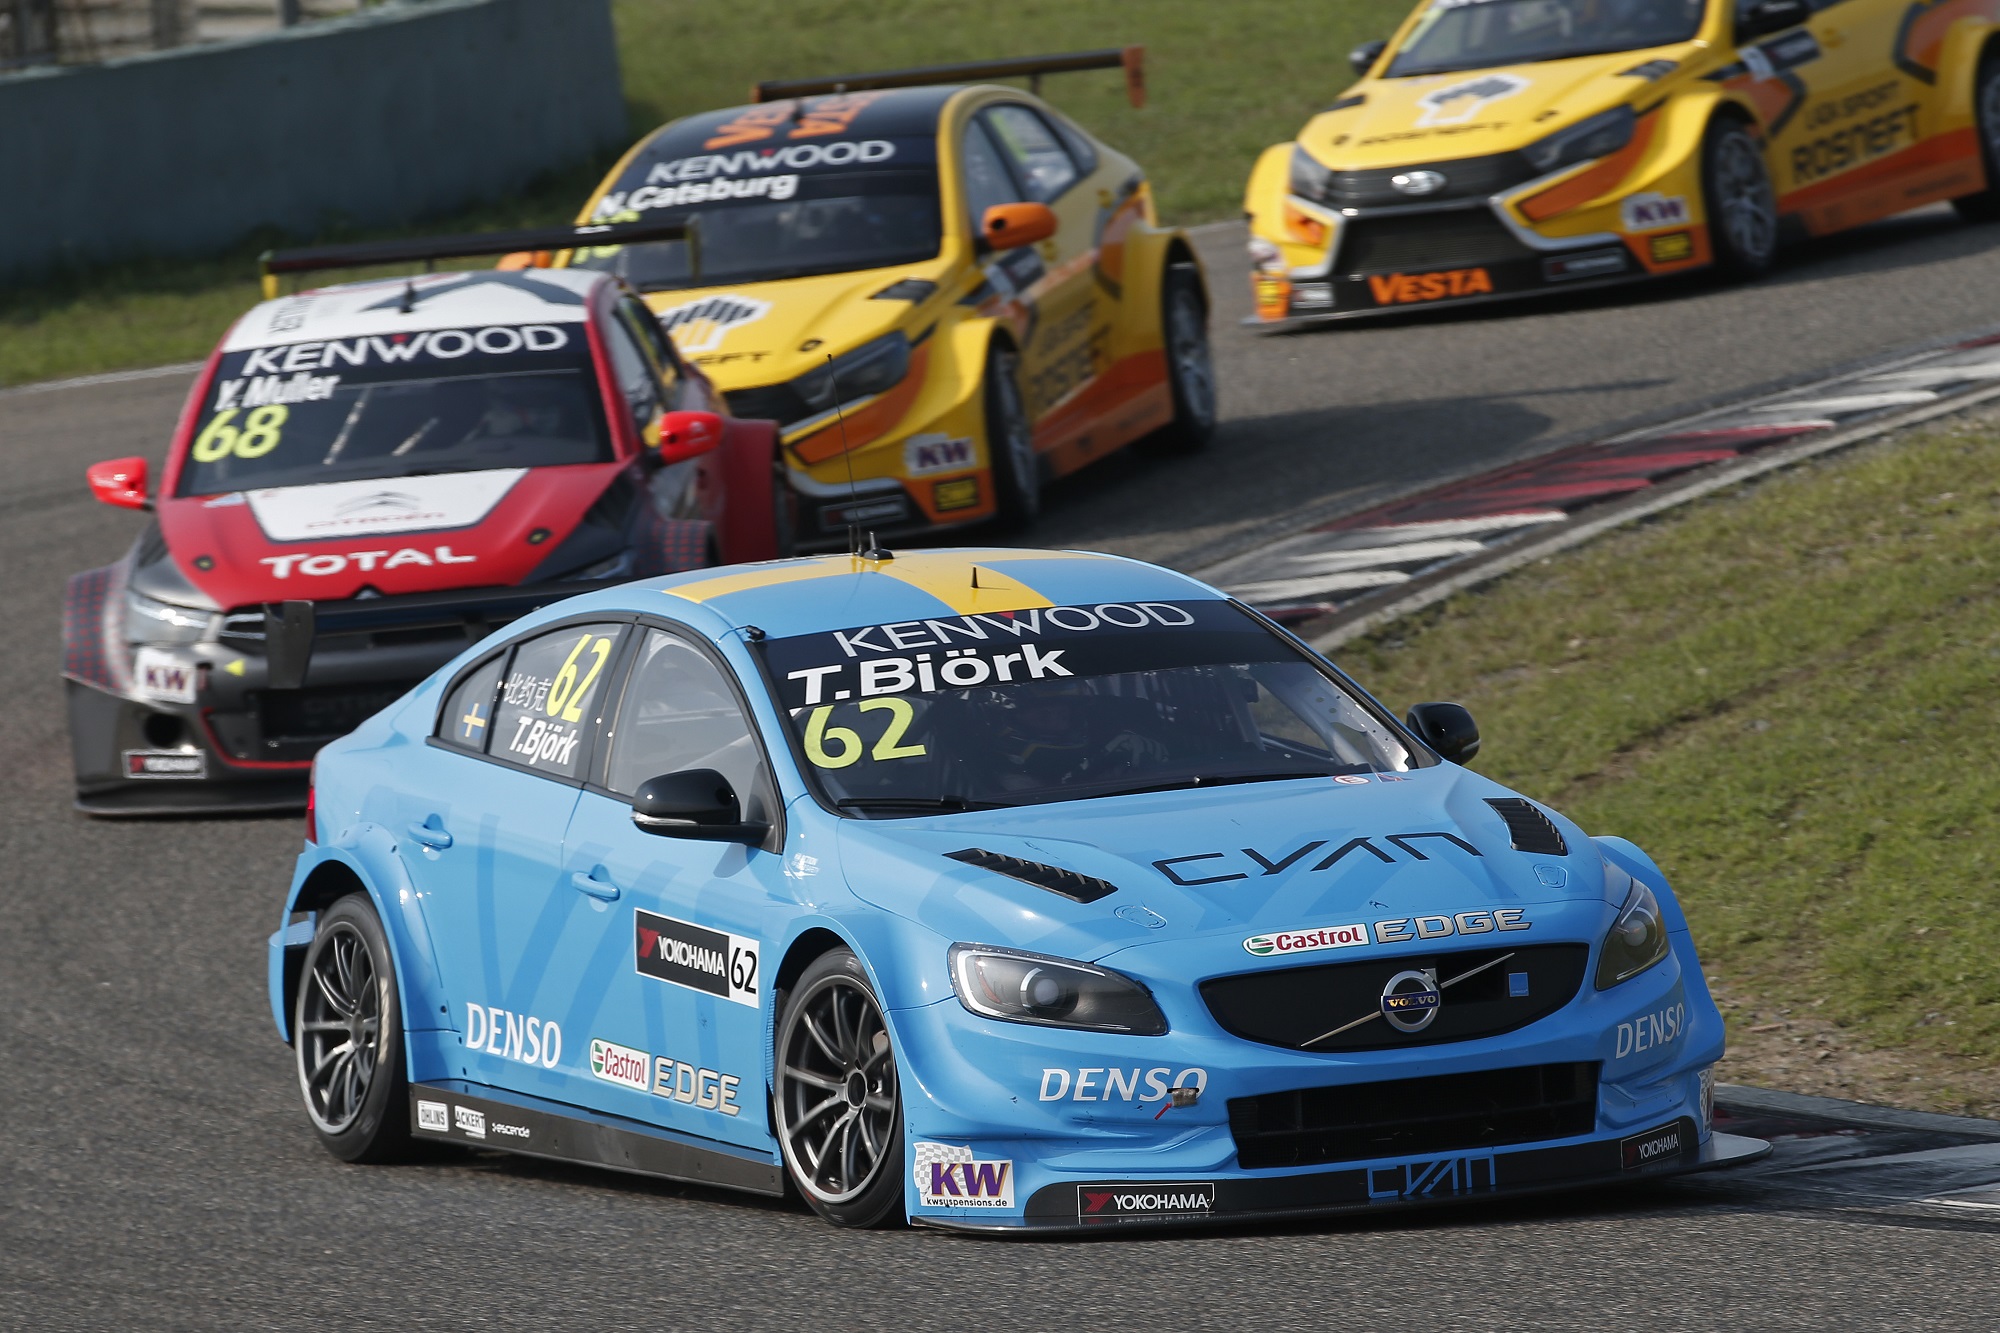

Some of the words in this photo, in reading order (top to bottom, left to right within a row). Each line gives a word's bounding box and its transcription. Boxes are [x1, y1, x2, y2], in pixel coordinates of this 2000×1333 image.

[645, 139, 897, 185] KENWOOD
[1367, 267, 1494, 305] VESTA
[241, 324, 569, 377] KENWOOD
[191, 404, 289, 463] 68
[258, 545, 477, 579] TOTAL
[832, 602, 1195, 658] KENWOOD
[546, 633, 611, 723] 62
[508, 715, 579, 765] T.Björk
[803, 697, 927, 769] 62
[1275, 926, 1363, 951] Castrol
[1372, 907, 1534, 945] EDGE
[657, 935, 726, 978] YOKOHAMA
[730, 946, 757, 995] 62
[465, 1001, 562, 1069] DENSO
[1615, 1002, 1685, 1059] DENSO
[604, 1047, 646, 1086] Castrol
[651, 1055, 741, 1117] EDGE
[1038, 1067, 1208, 1102] DENSO
[1638, 1133, 1679, 1160] YOKOHAMA
[926, 1197, 1008, 1208] kwsuspensions.de
[930, 1162, 1011, 1197] KW
[1113, 1193, 1209, 1210] YOKOHAMA
